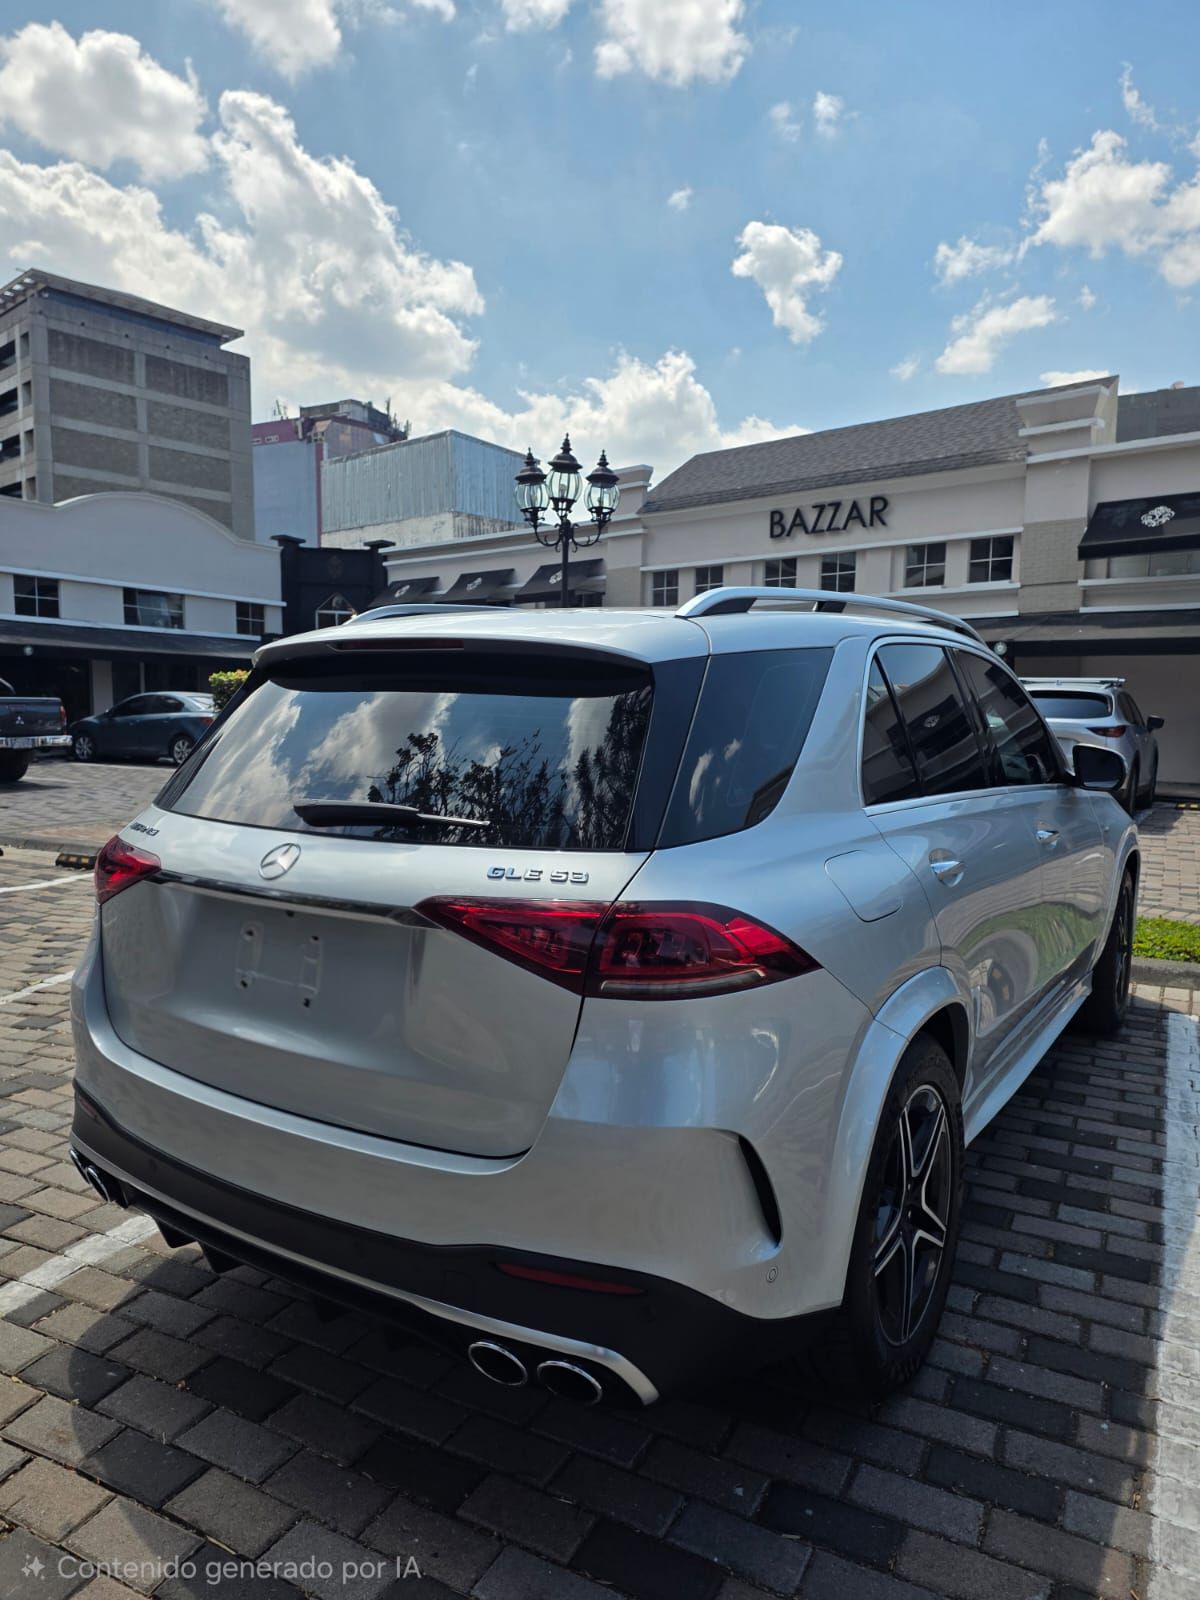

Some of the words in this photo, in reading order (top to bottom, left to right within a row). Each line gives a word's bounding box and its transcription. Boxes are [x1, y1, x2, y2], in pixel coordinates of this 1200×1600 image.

[769, 495, 889, 539] BAZZAR
[486, 865, 544, 881] GLE
[549, 869, 590, 884] 53
